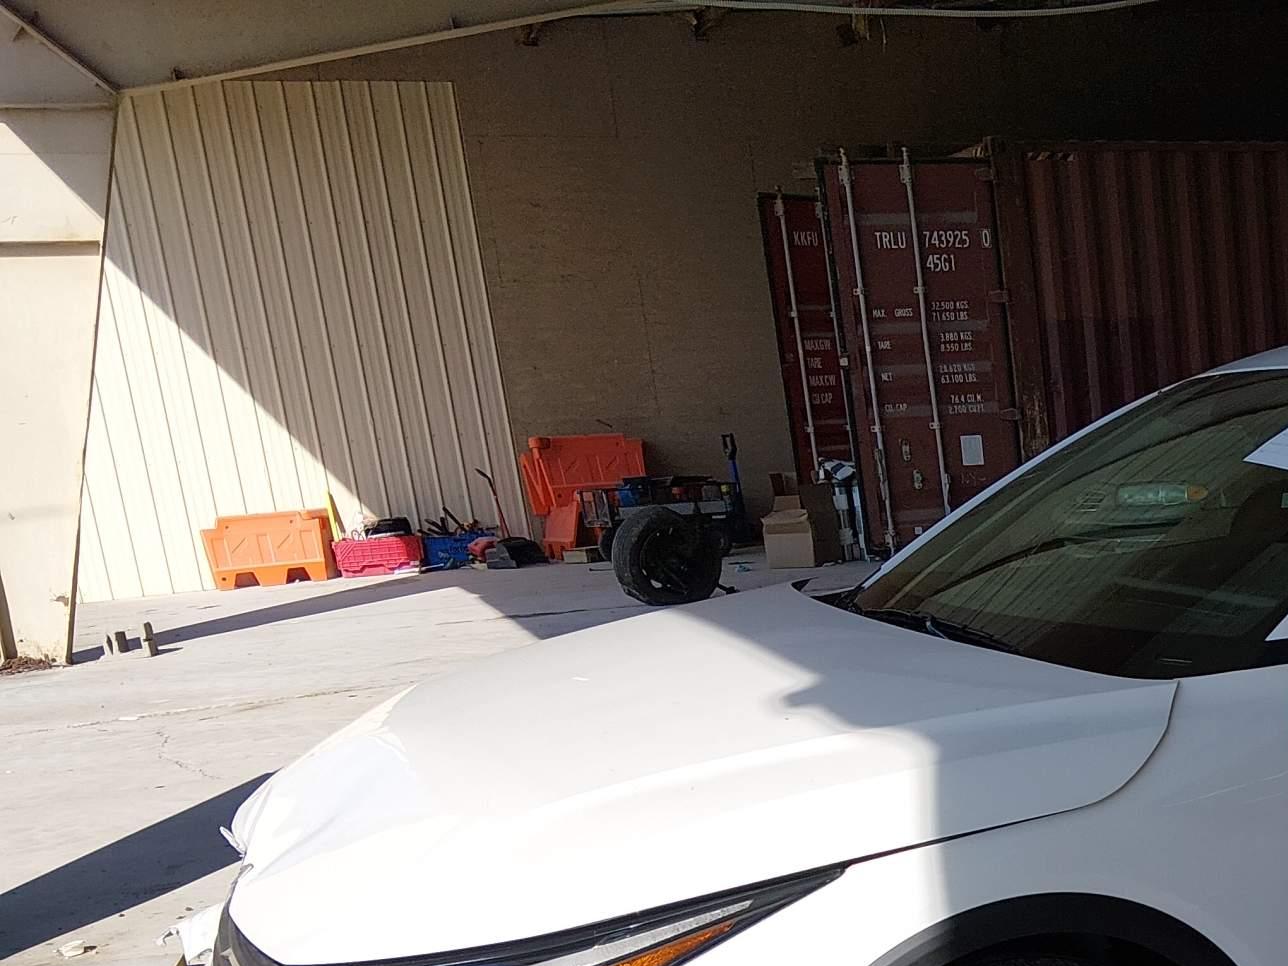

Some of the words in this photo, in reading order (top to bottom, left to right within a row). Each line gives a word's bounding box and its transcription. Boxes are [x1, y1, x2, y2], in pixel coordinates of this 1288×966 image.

[873, 230, 907, 249] TRLU
[922, 230, 970, 249] 743925
[981, 229, 992, 248] 0
[926, 254, 957, 272] 45G1
